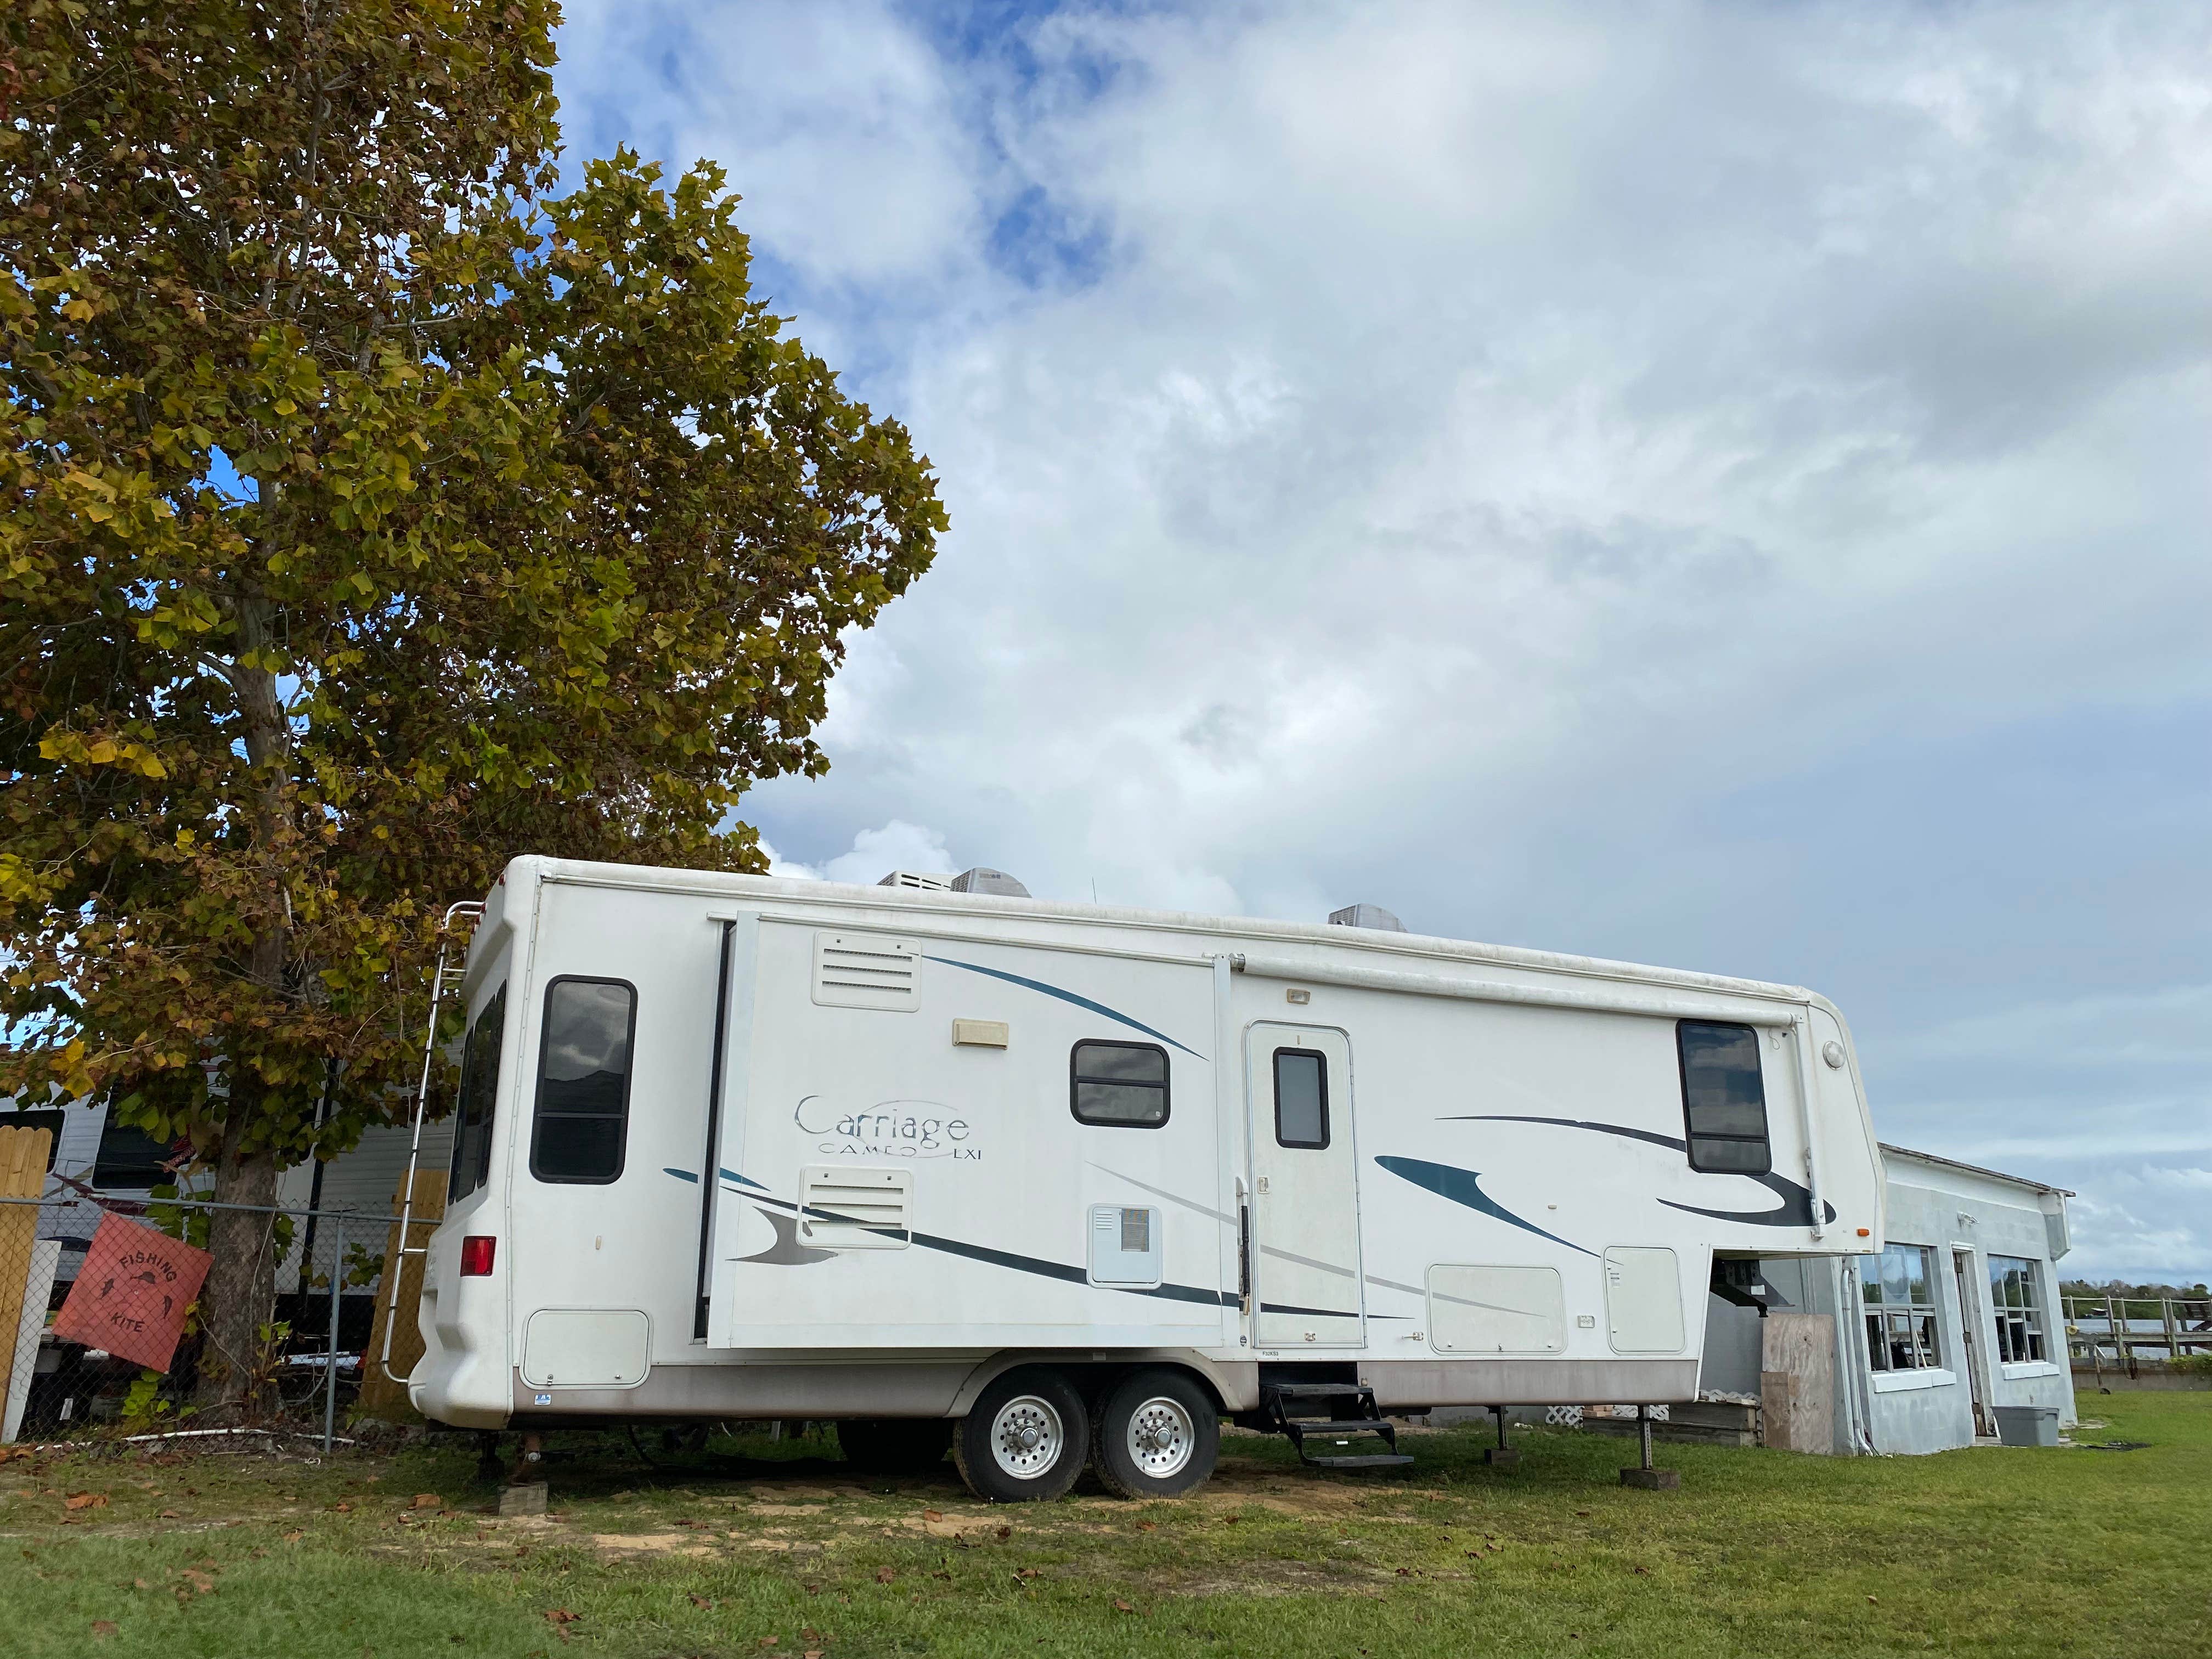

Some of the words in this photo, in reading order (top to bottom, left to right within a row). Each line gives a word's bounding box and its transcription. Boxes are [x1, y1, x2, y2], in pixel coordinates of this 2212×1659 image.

[794, 1095, 969, 1149] Carriage
[953, 1148, 981, 1160] LXI
[119, 1250, 177, 1282] FISHING
[110, 1312, 145, 1333] KITE
